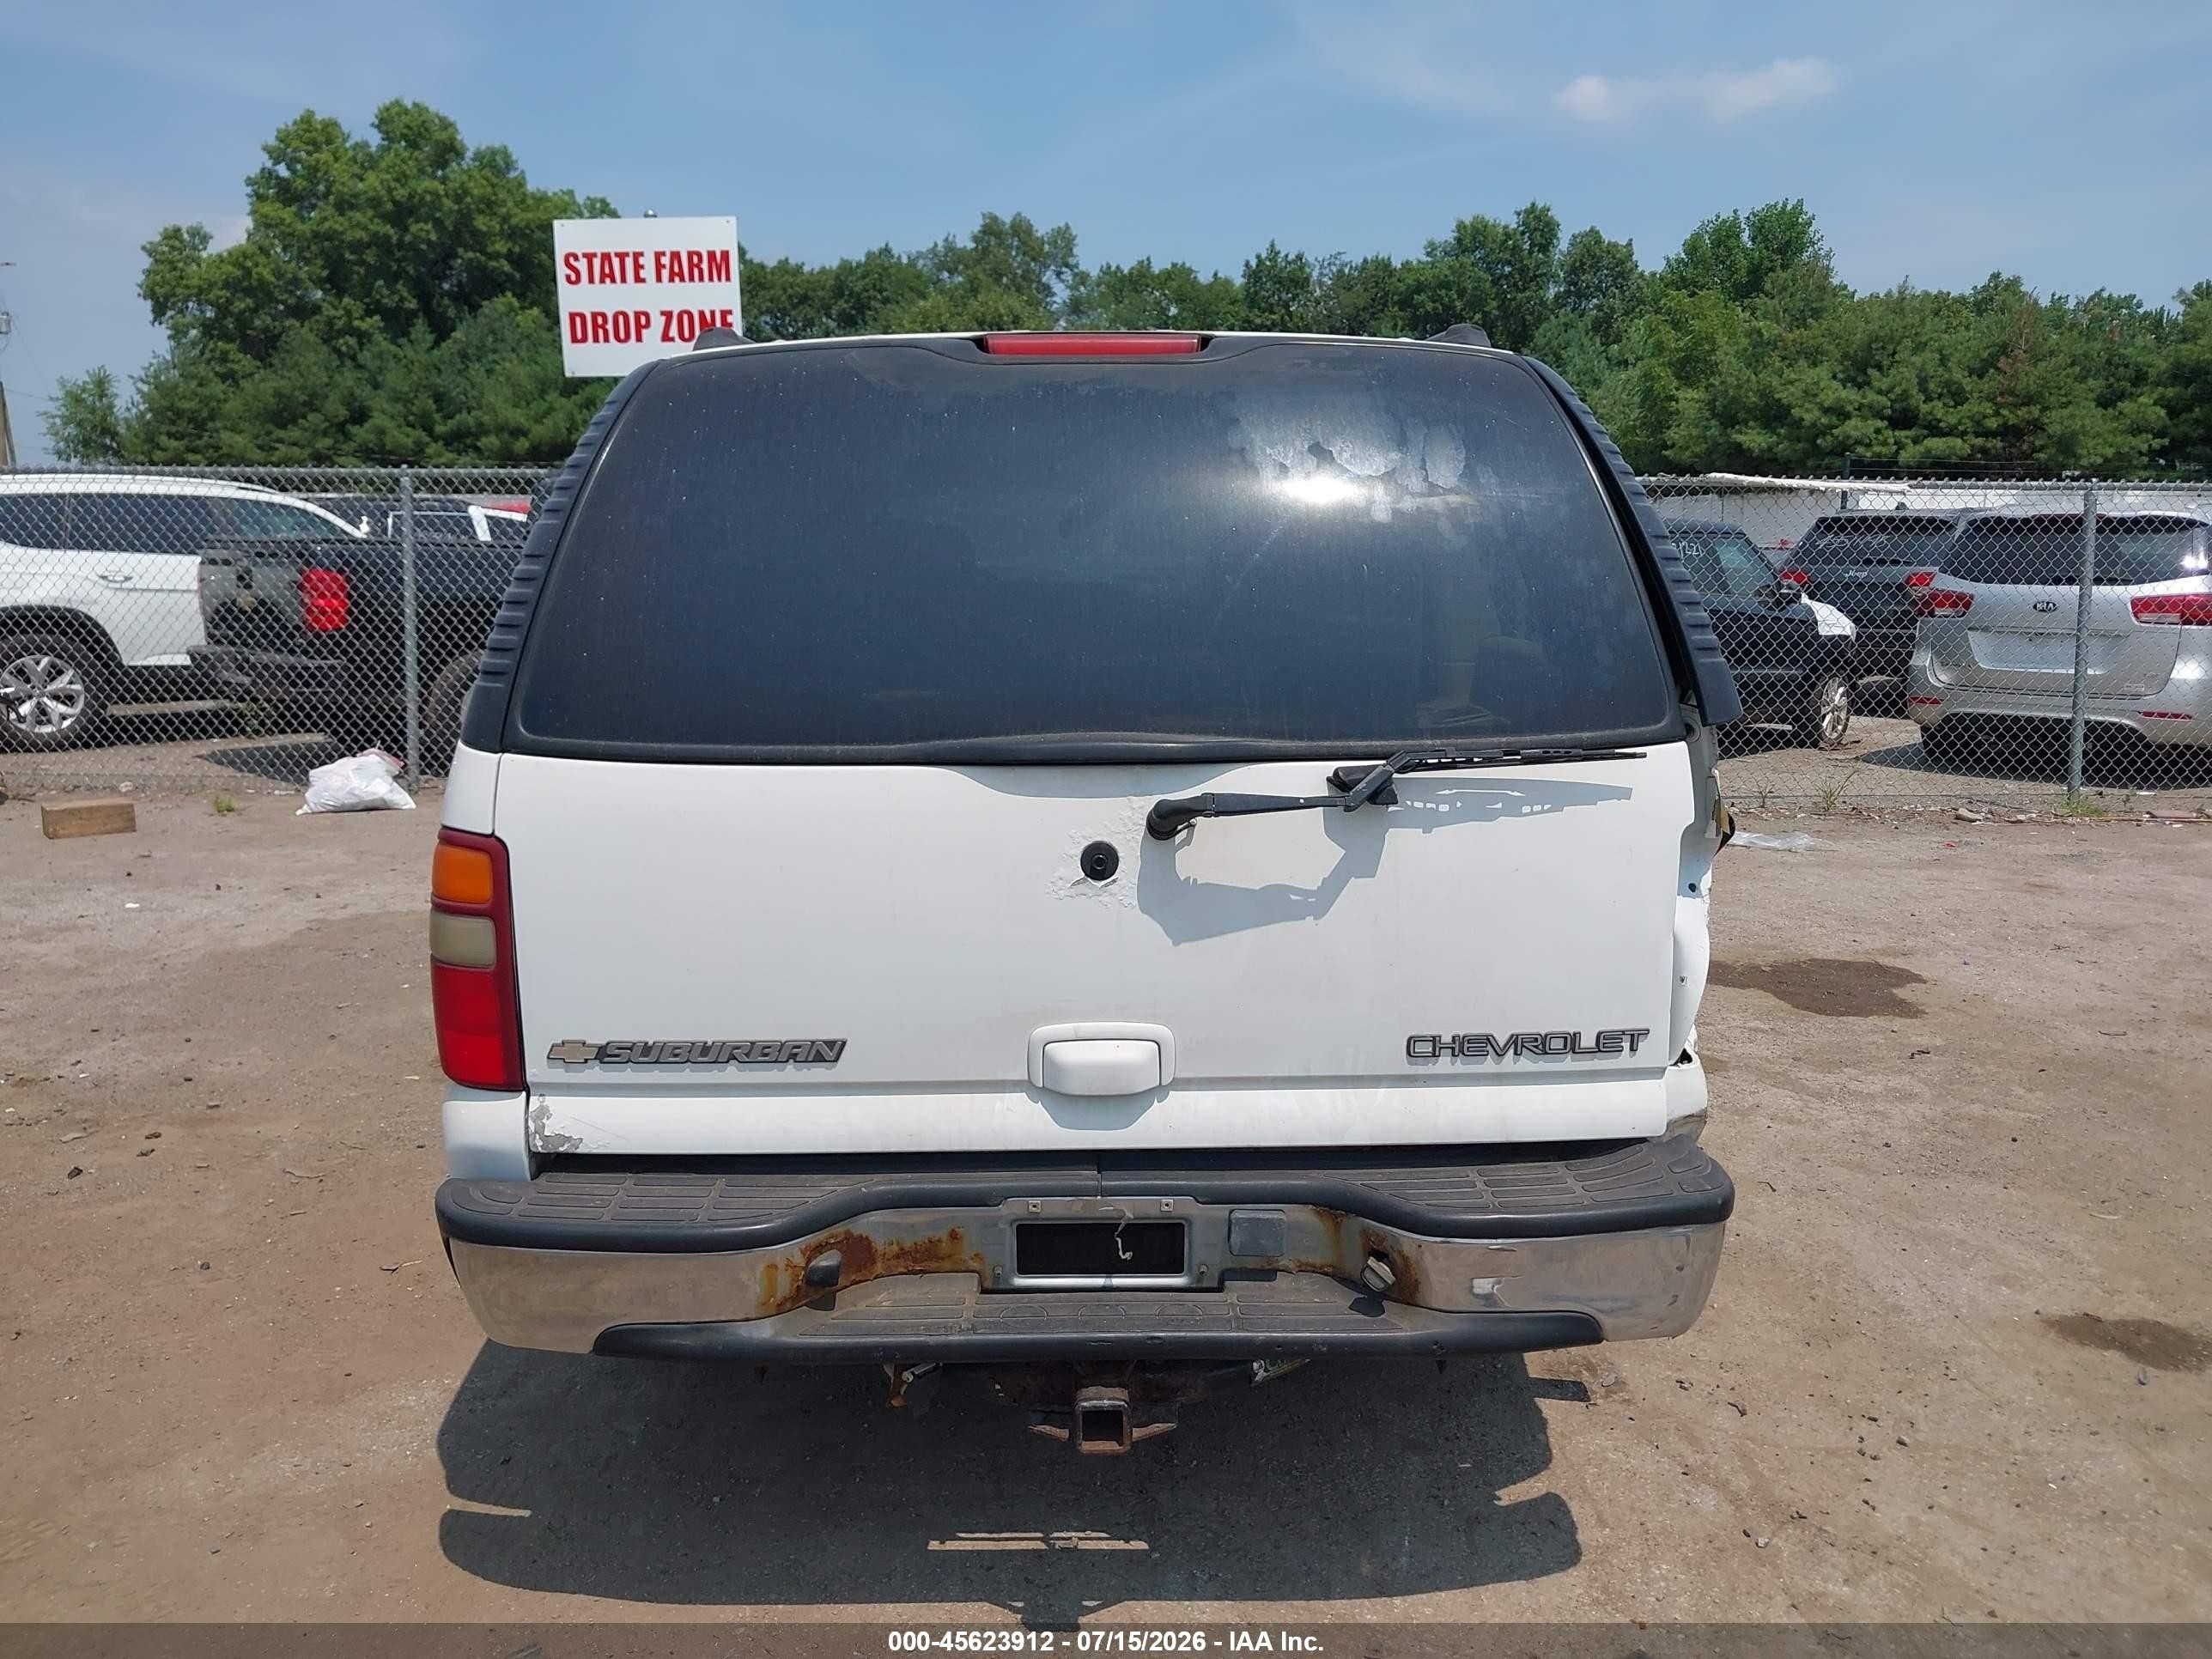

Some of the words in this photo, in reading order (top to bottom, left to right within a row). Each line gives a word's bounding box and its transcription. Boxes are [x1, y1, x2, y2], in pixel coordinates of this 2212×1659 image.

[564, 251, 647, 286] STATE
[653, 250, 732, 283] FARM
[568, 310, 651, 343] DROP
[599, 1040, 847, 1063] SUBURBAN
[1406, 1028, 1650, 1057] CHEVROLET
